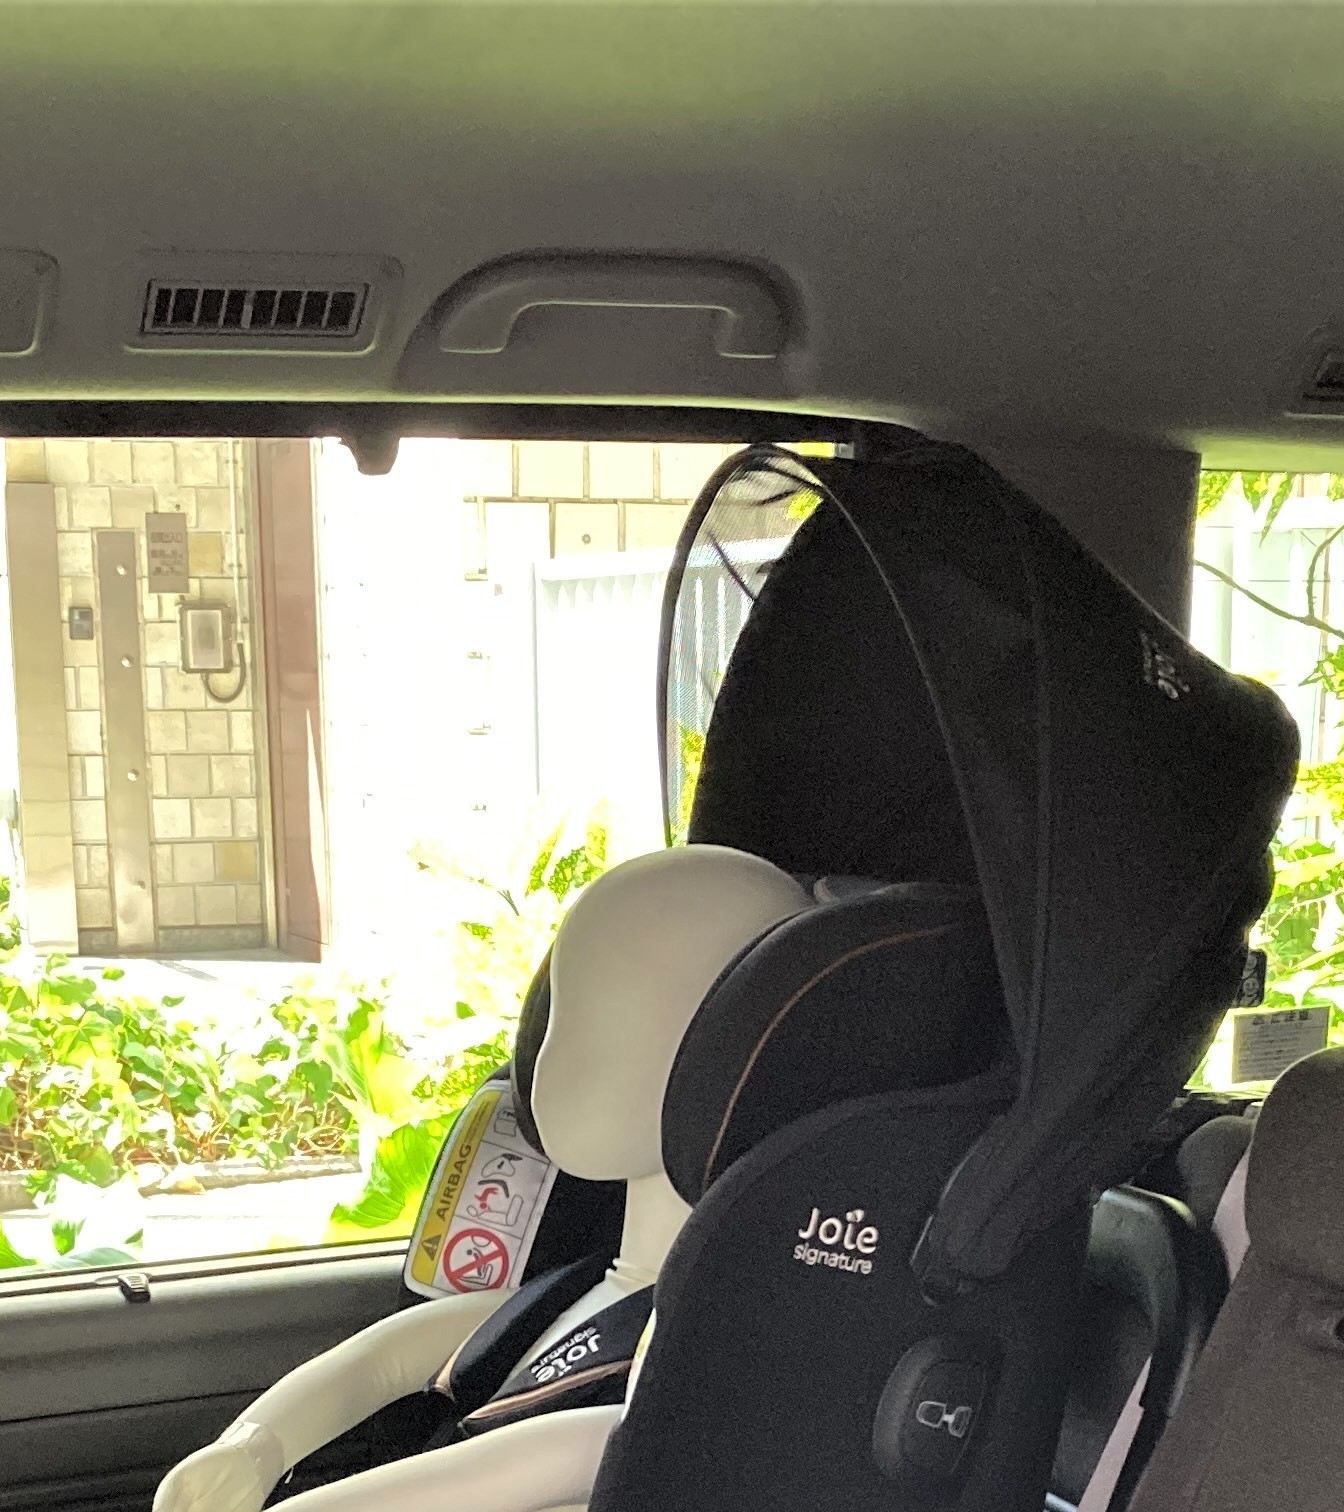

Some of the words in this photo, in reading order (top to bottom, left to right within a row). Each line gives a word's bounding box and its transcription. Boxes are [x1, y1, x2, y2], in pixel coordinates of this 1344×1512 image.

[436, 1142, 472, 1222] AIRBAG
[798, 1207, 879, 1254] Joie
[793, 1242, 873, 1275] signature
[535, 1334, 601, 1382] Joie
